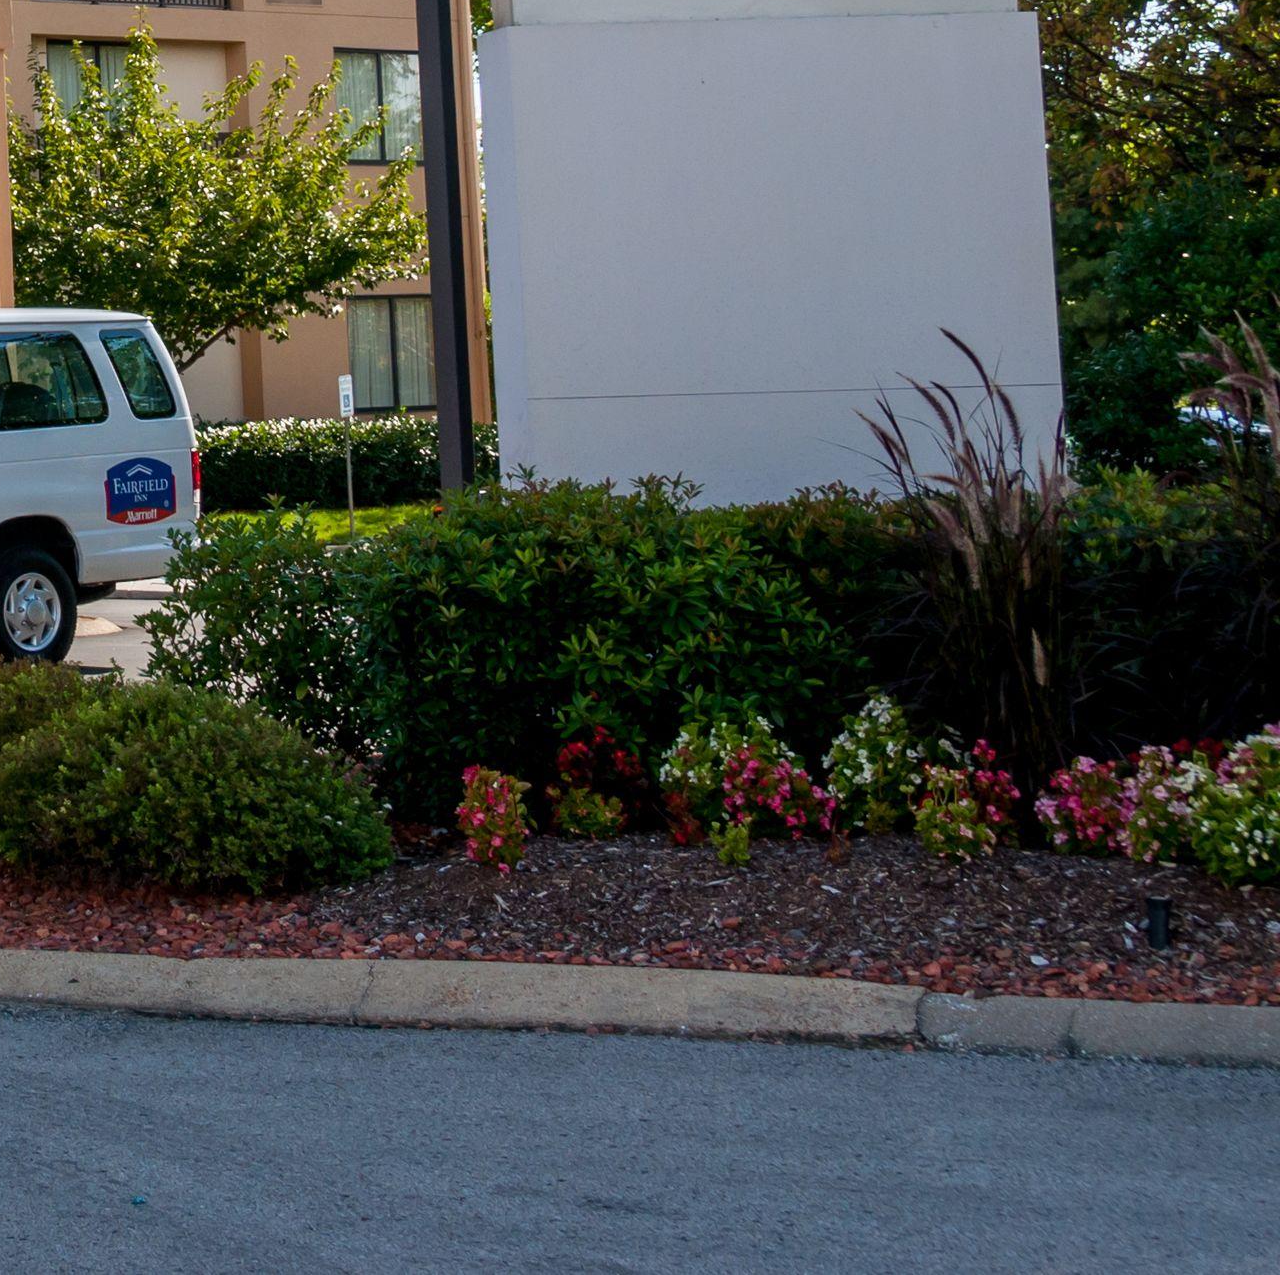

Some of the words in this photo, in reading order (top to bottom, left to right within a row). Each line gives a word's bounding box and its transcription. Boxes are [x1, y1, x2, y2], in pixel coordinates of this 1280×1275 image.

[113, 478, 168, 495] FAIRFIELD
[134, 494, 148, 503] INN
[125, 509, 158, 524] Marriott
